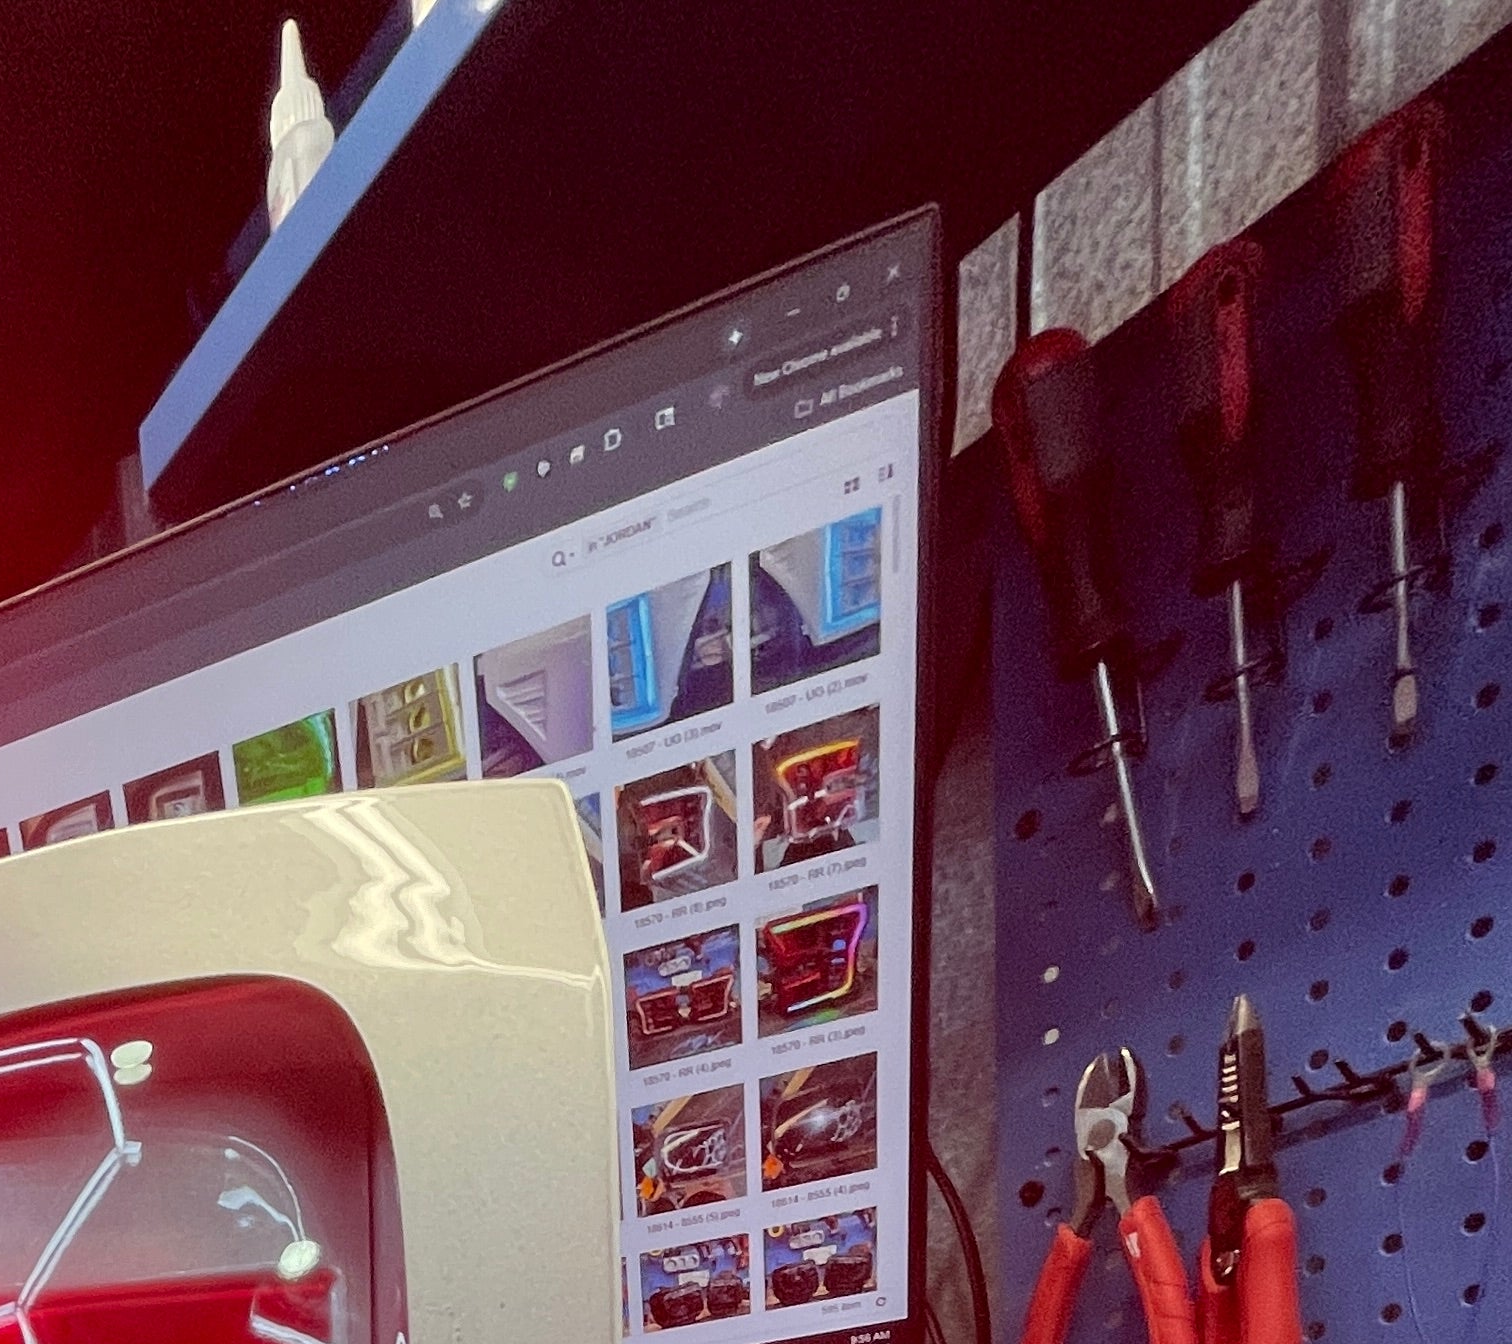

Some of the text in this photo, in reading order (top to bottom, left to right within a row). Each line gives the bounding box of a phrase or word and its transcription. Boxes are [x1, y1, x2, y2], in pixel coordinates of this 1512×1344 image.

[782, 350, 828, 375] Chrome
[839, 366, 904, 399] Bookmarks
[873, 1330, 891, 1341] AM
